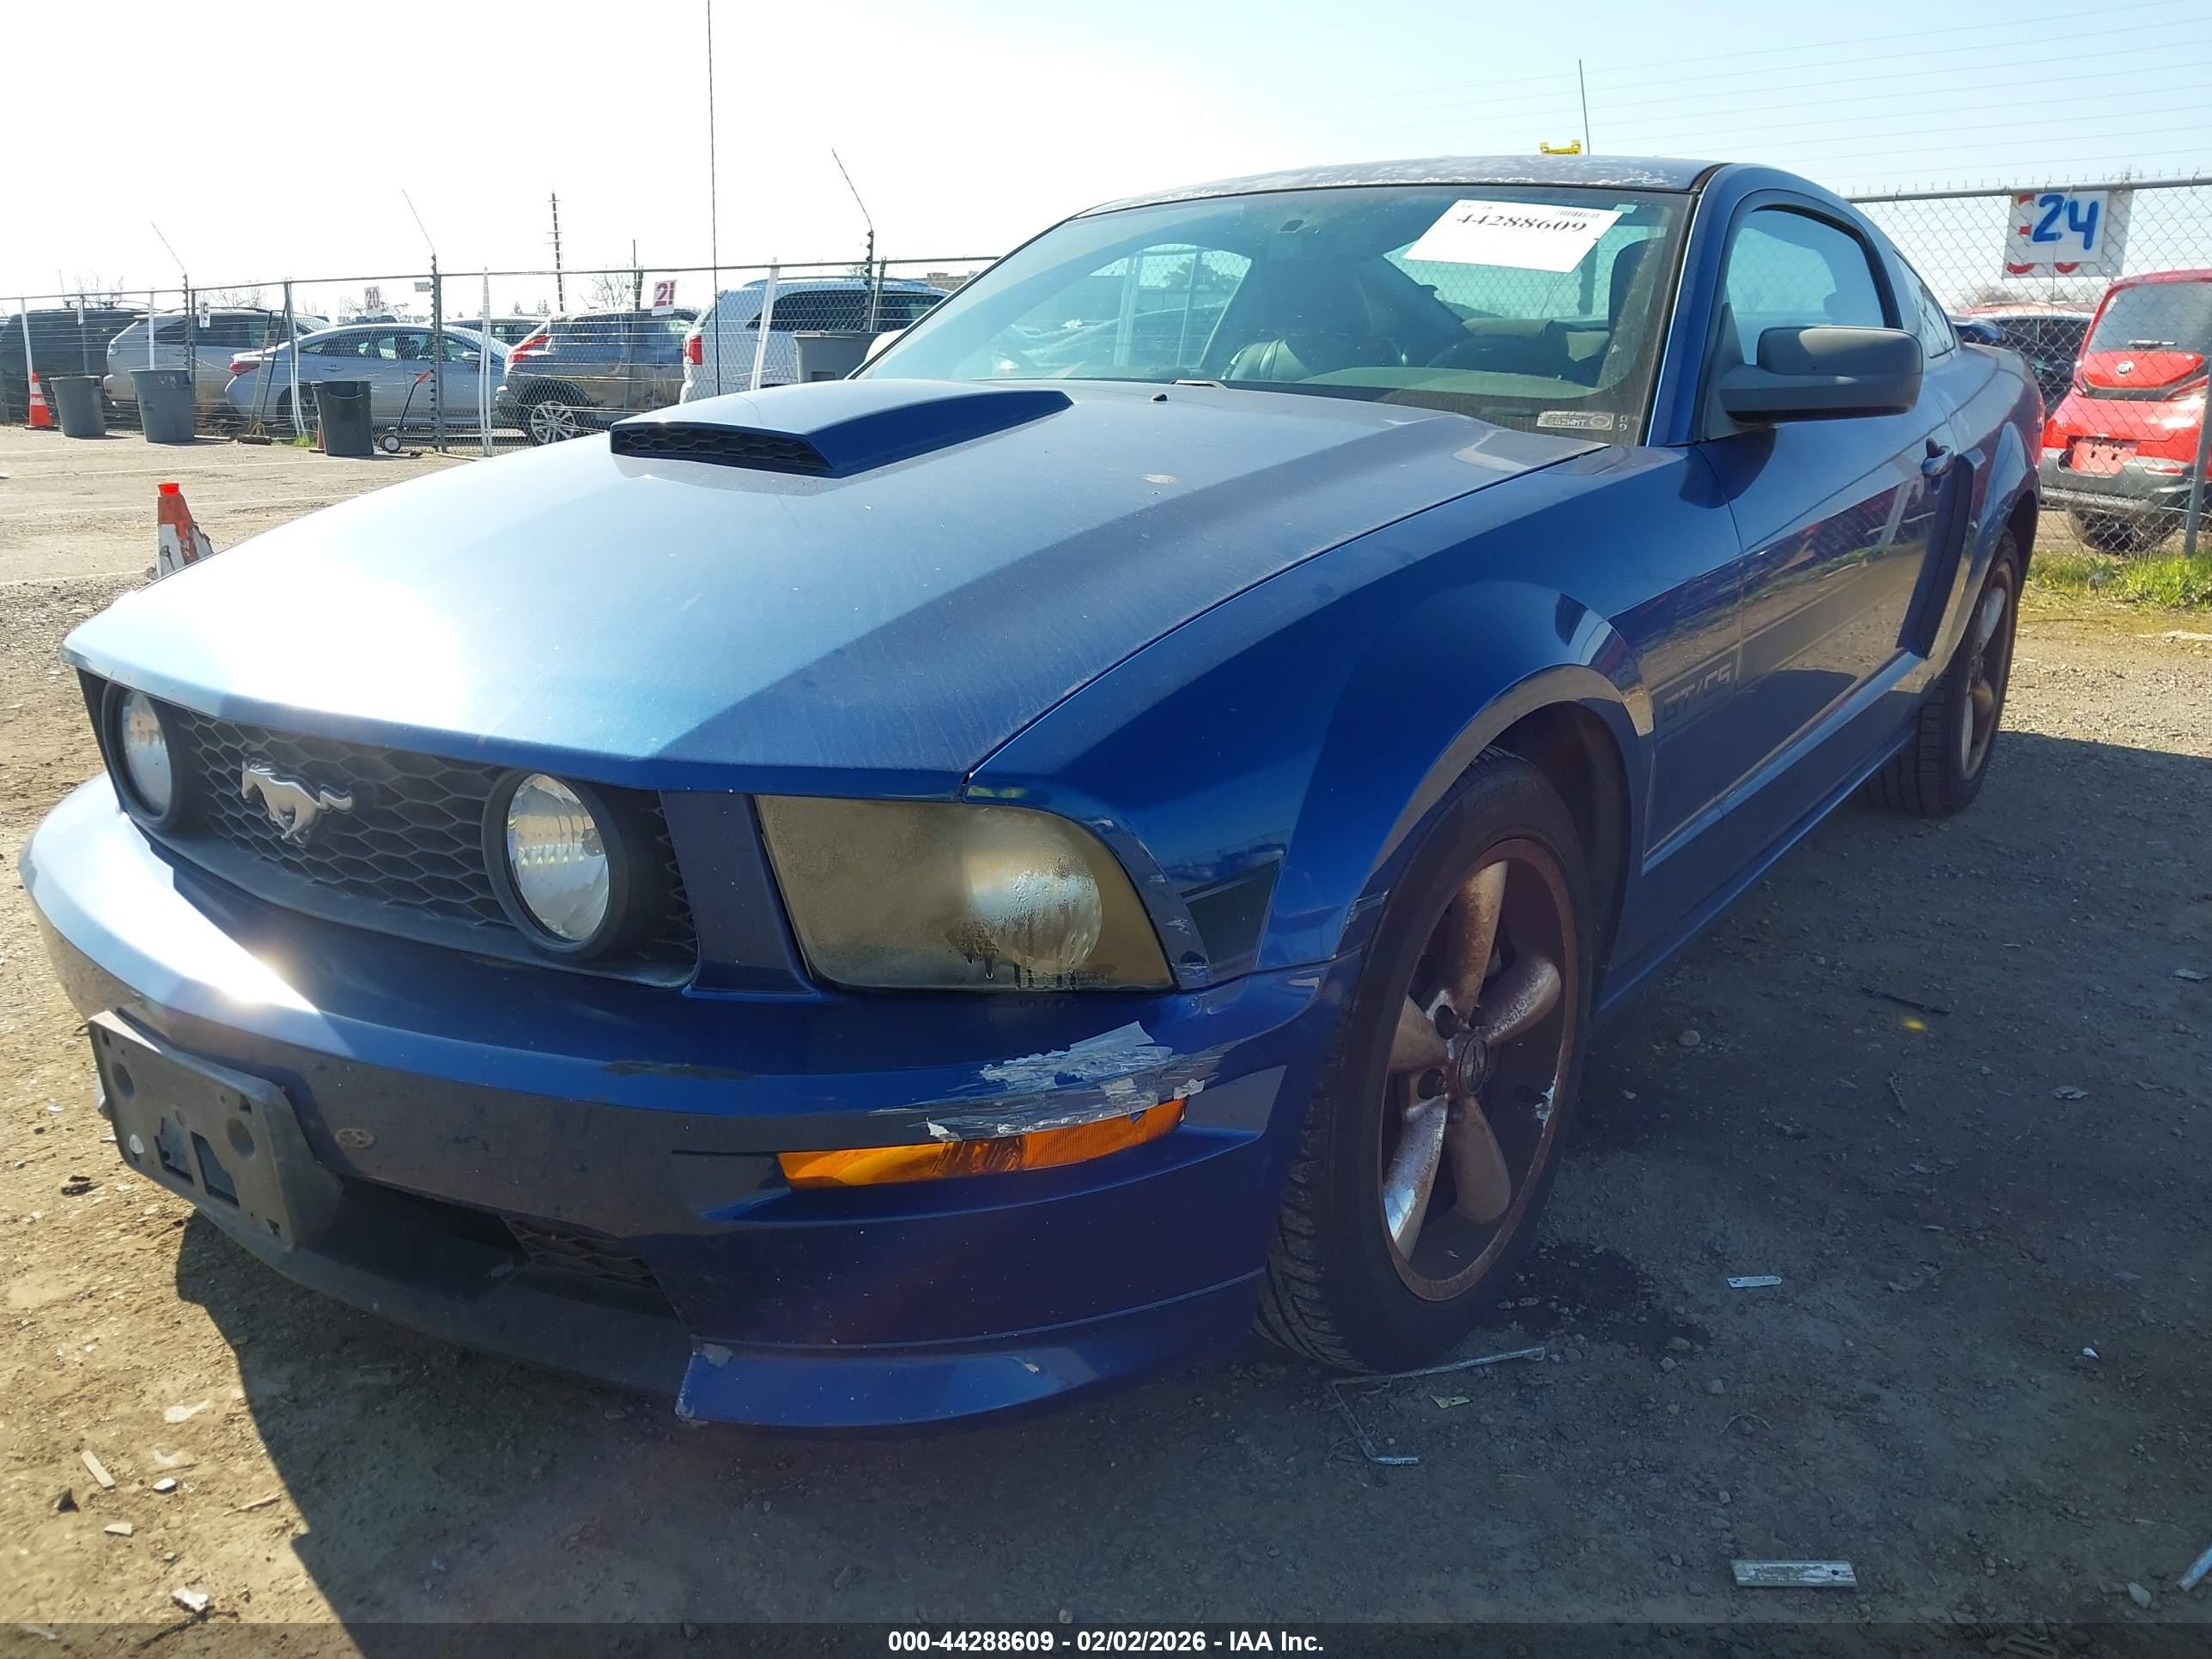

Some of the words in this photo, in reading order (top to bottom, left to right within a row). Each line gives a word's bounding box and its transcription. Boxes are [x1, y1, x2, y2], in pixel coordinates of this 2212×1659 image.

[1456, 213, 1588, 233] 44288609
[2032, 194, 2099, 251] 24
[365, 288, 380, 310] 20
[654, 281, 675, 307] 21
